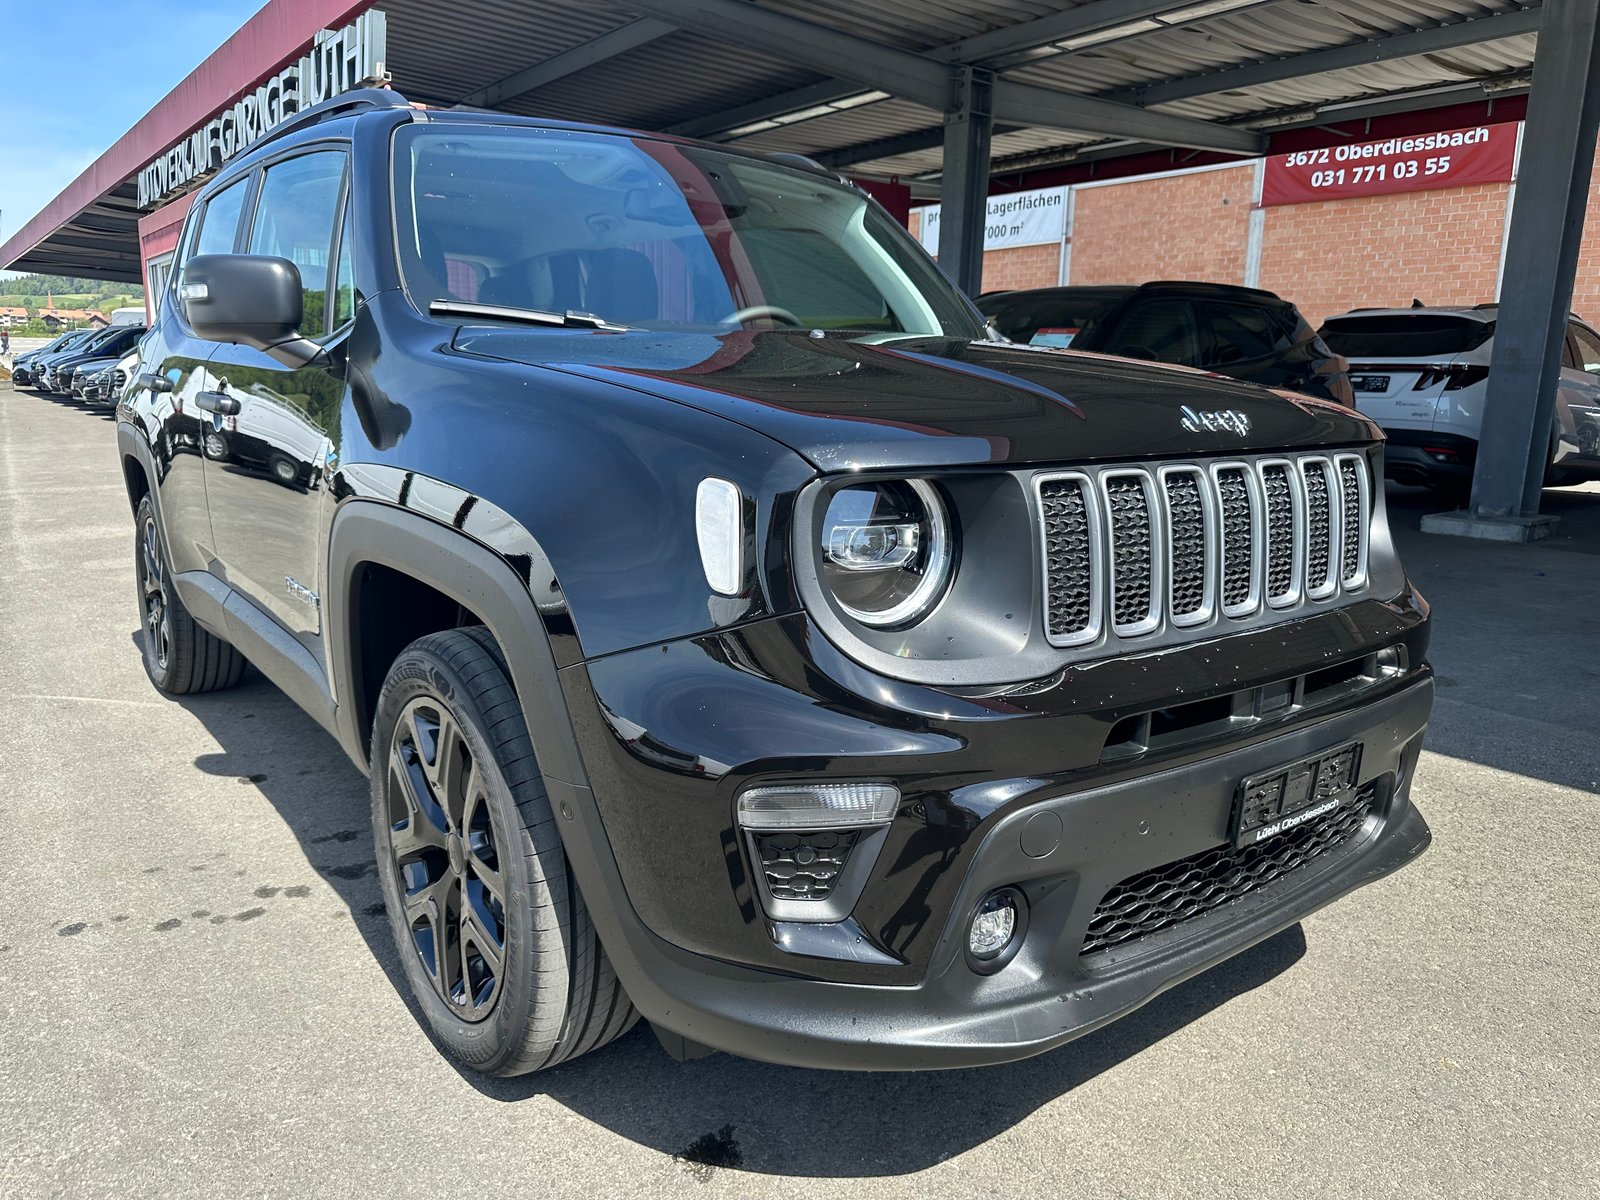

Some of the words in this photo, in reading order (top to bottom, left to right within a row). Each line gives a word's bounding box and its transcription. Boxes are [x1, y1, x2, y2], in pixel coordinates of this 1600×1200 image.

[137, 119, 220, 209] AUTOVERKAUF
[220, 66, 298, 161] GARAGE
[299, 8, 386, 113] LÜTHI
[1285, 148, 1330, 168] 3672
[1335, 127, 1489, 162] Oberdiessbach
[1311, 169, 1345, 187] 031
[1352, 164, 1387, 184] 771
[1393, 160, 1418, 179] 03
[1424, 156, 1451, 175] 55
[987, 193, 1061, 217] Lagerflächen
[1180, 405, 1252, 438] Jeep
